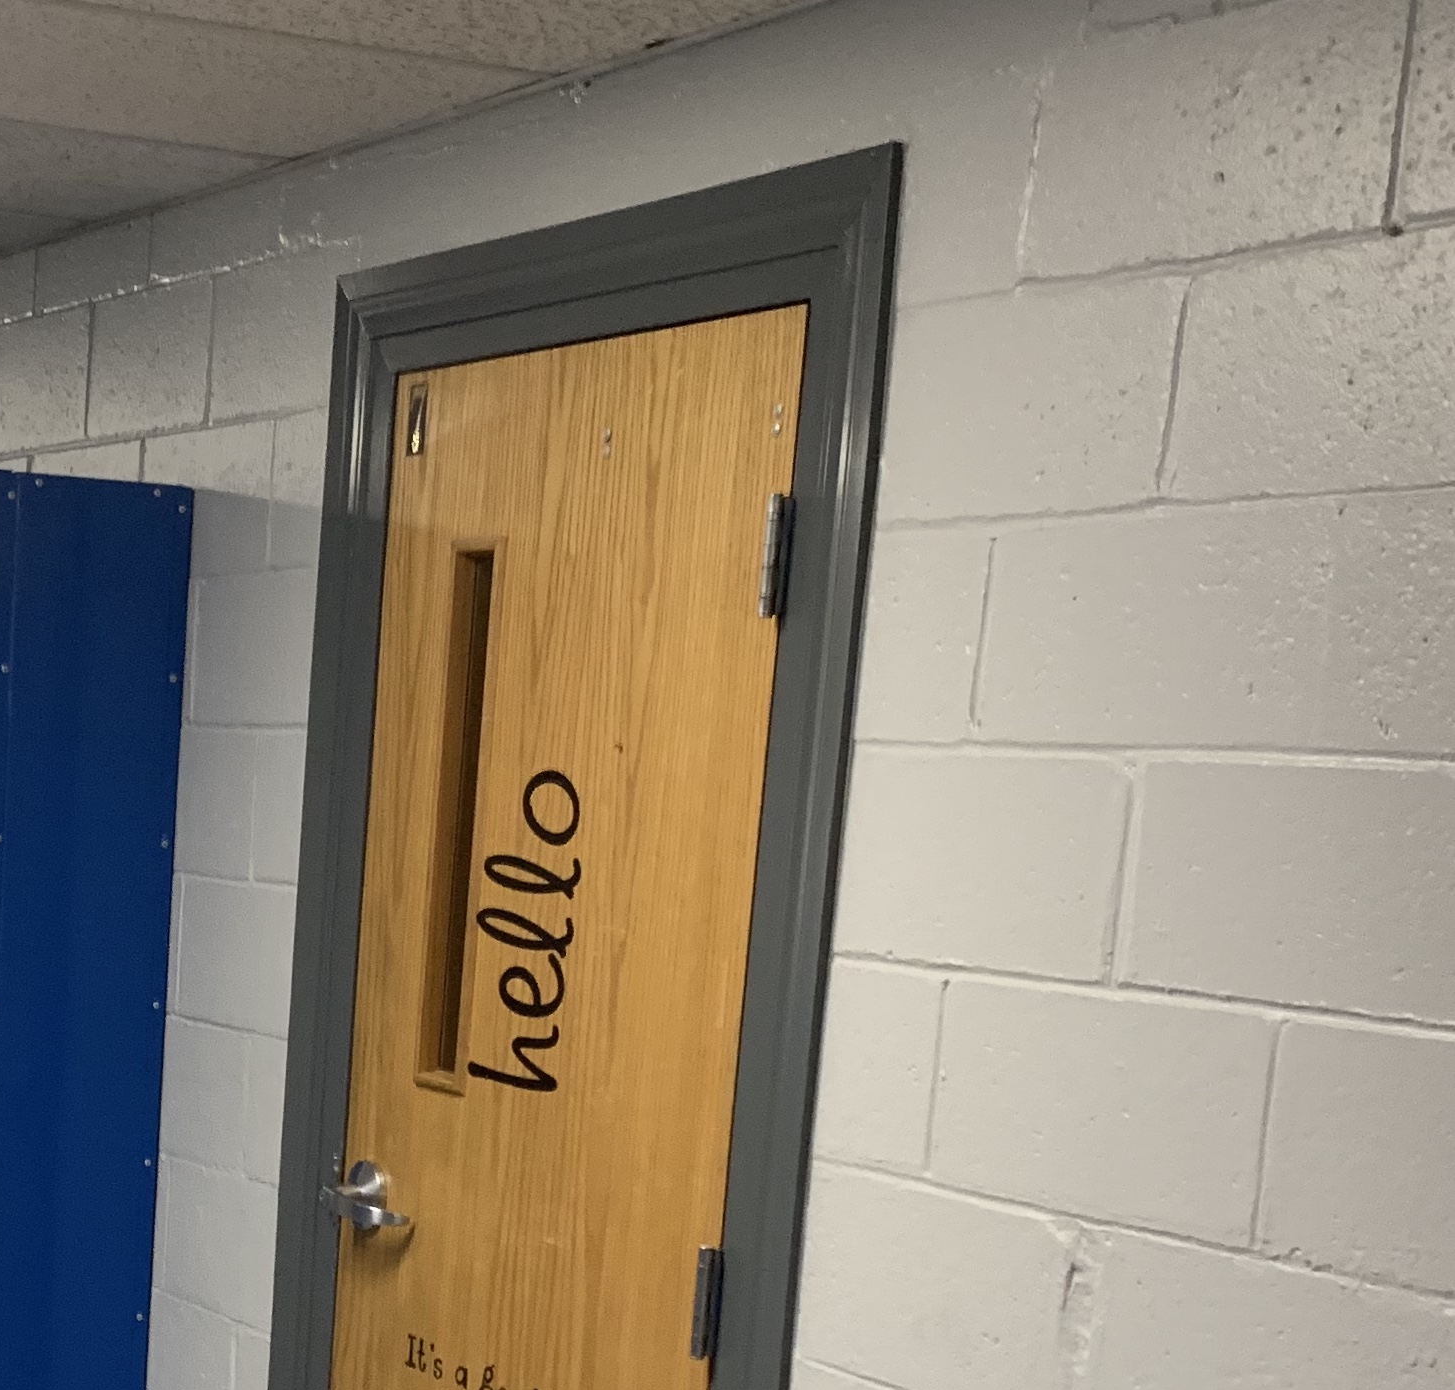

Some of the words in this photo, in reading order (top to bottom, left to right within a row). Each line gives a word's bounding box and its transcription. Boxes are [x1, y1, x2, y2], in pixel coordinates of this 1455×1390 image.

[468, 770, 581, 1092] hello
[405, 1333, 443, 1380] It's
[455, 1365, 469, 1390] a
